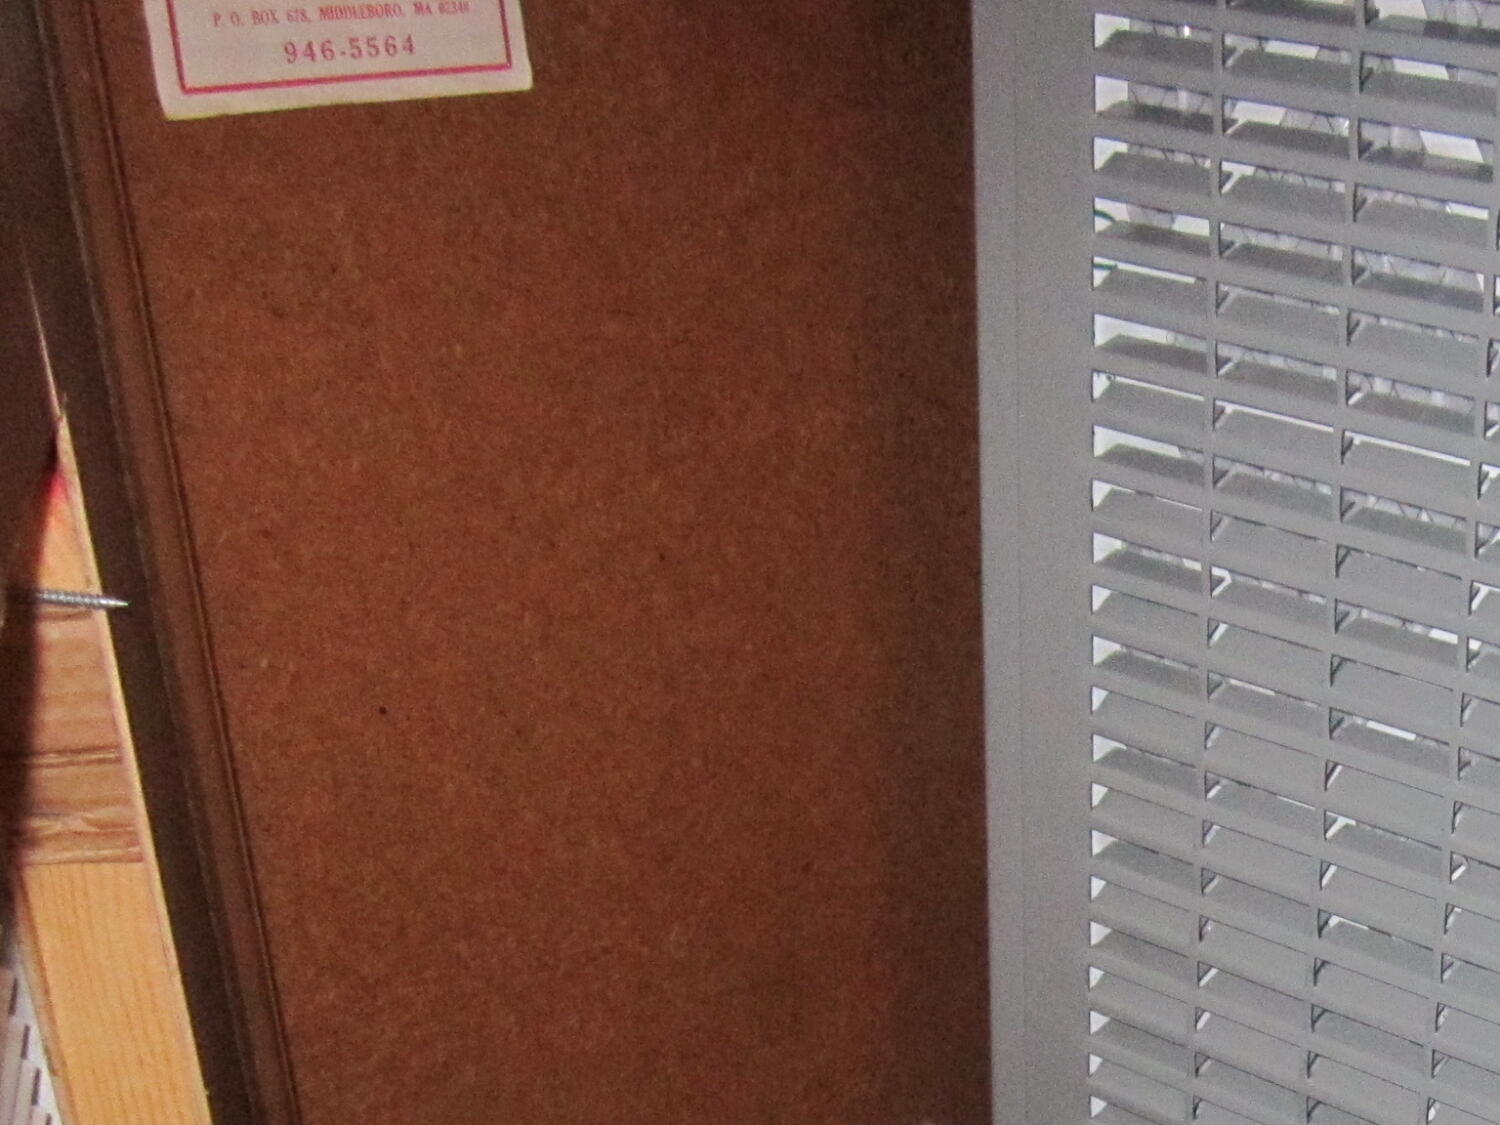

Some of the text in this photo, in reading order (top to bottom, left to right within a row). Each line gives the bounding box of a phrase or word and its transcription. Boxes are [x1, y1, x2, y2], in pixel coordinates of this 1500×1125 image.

[252, 9, 279, 25] BOX
[413, 2, 433, 15] MA
[284, 34, 416, 64] 946-5564
